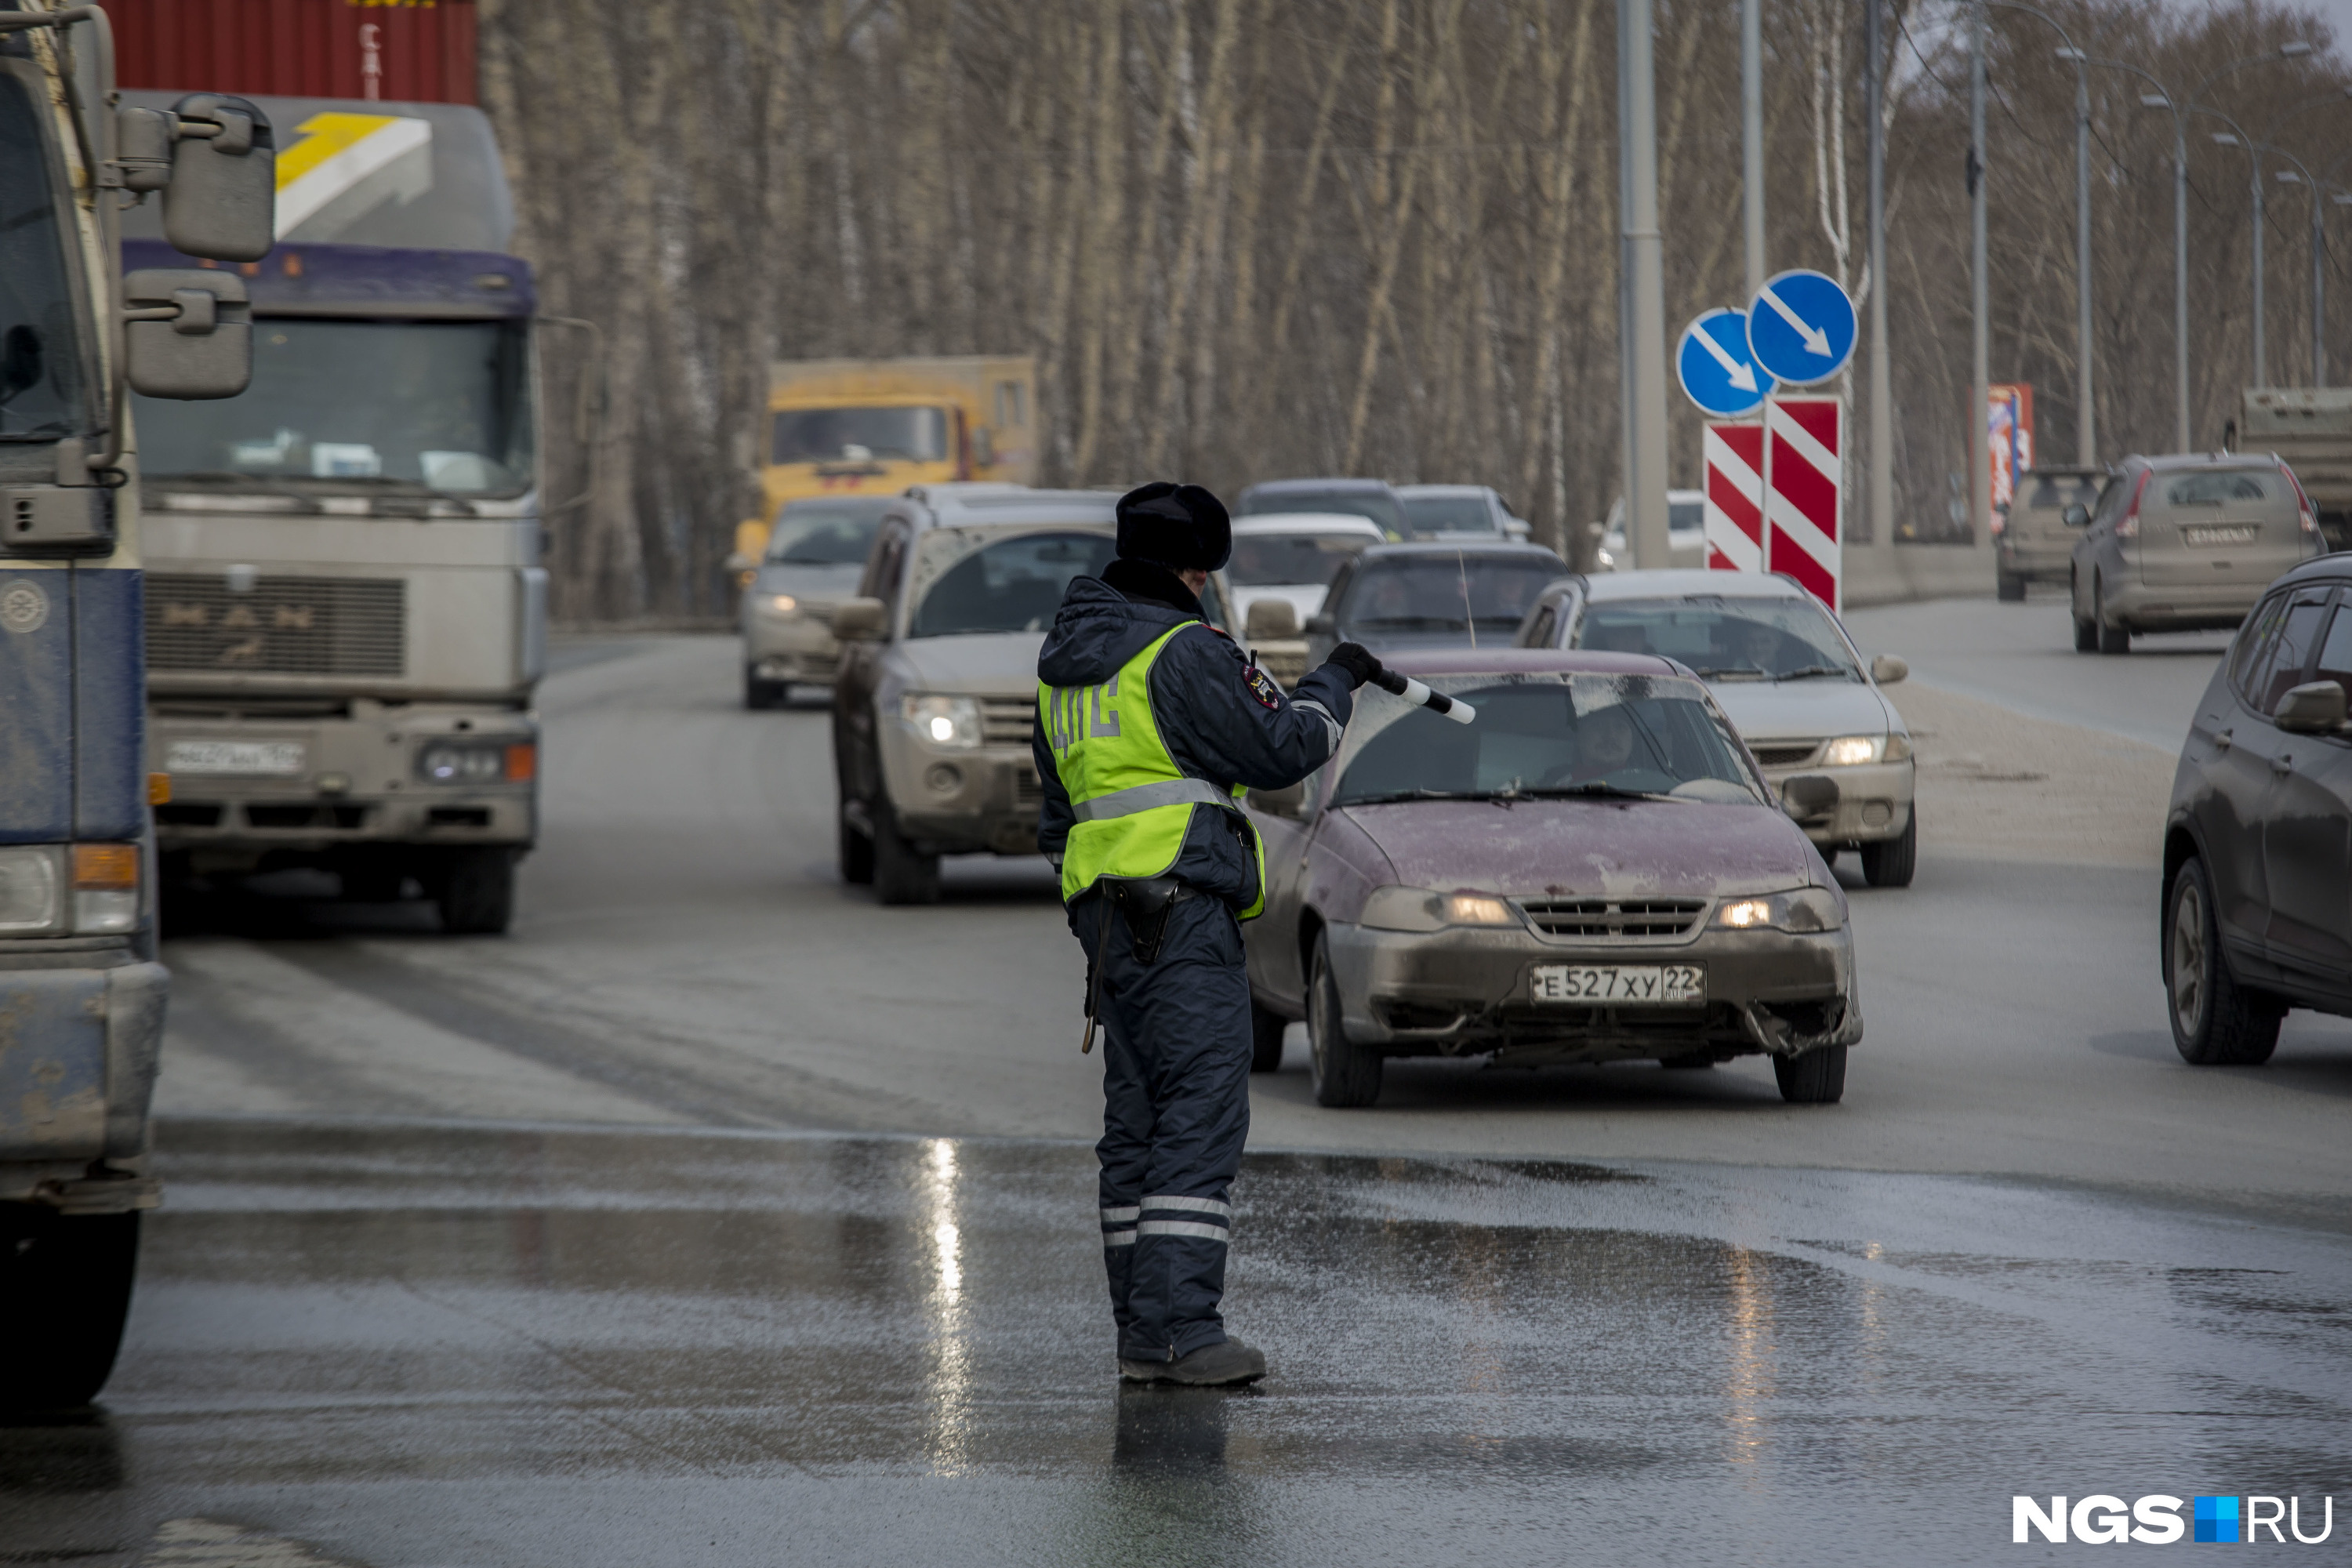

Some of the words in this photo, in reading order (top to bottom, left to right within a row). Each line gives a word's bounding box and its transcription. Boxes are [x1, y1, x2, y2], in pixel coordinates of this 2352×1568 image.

[162, 602, 314, 628] MAN
[1050, 671, 1120, 759] ДПС
[1665, 968, 1695, 989] 22
[1665, 989, 1686, 1000] RUS
